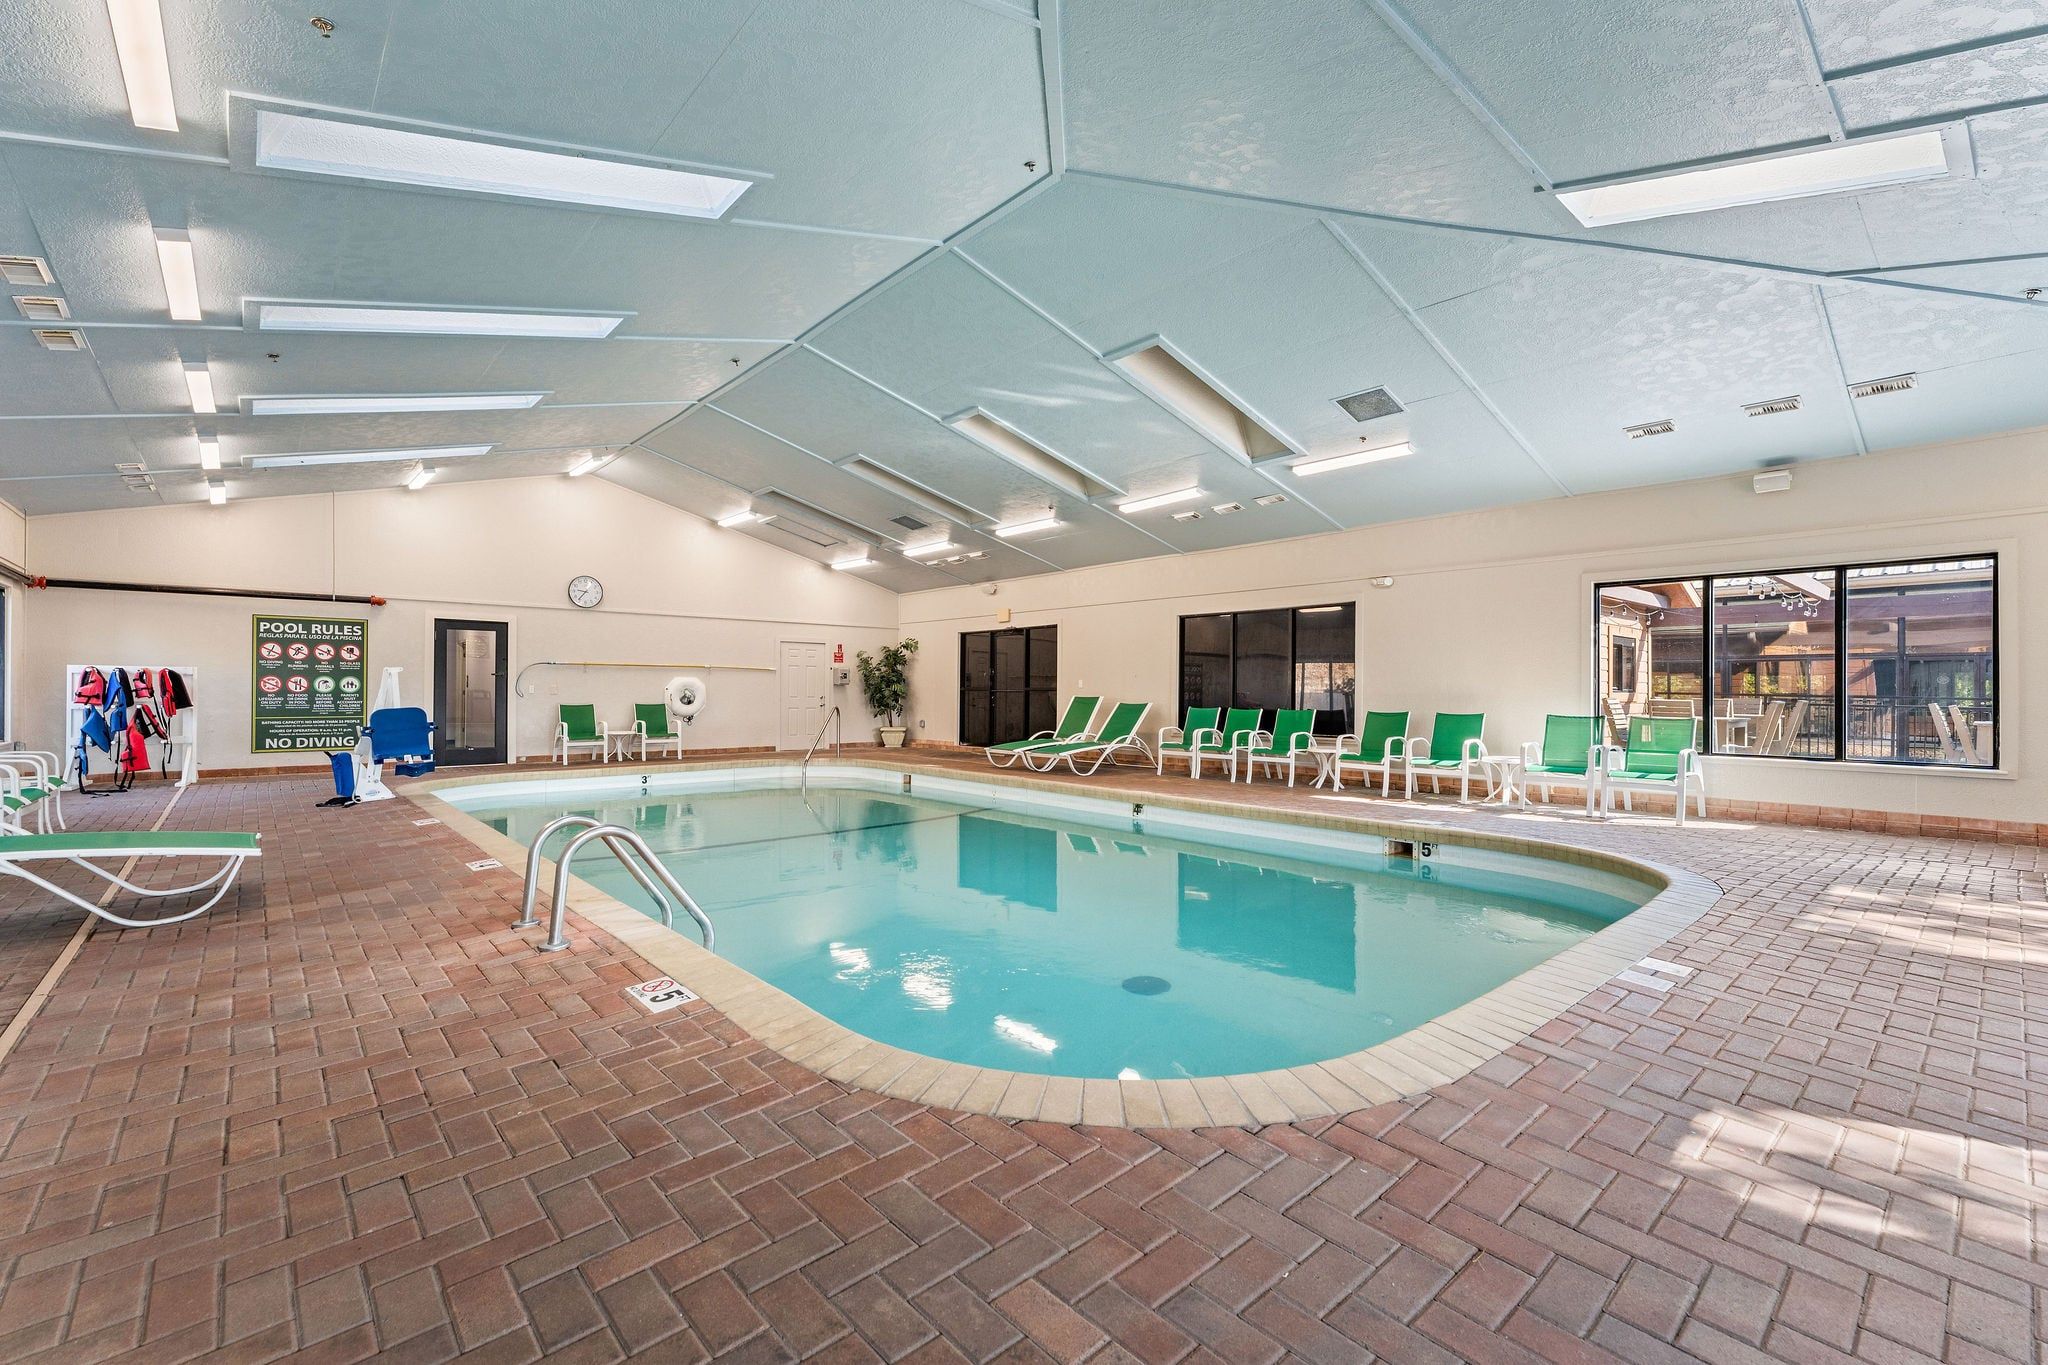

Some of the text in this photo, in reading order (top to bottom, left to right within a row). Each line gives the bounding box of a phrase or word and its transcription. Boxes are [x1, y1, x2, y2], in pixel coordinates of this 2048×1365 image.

[260, 622, 362, 635] POOL RULES
[265, 737, 355, 748] NO DIVING
[642, 776, 648, 784] 3
[1422, 842, 1432, 857] 5
[649, 990, 685, 1003] 5
